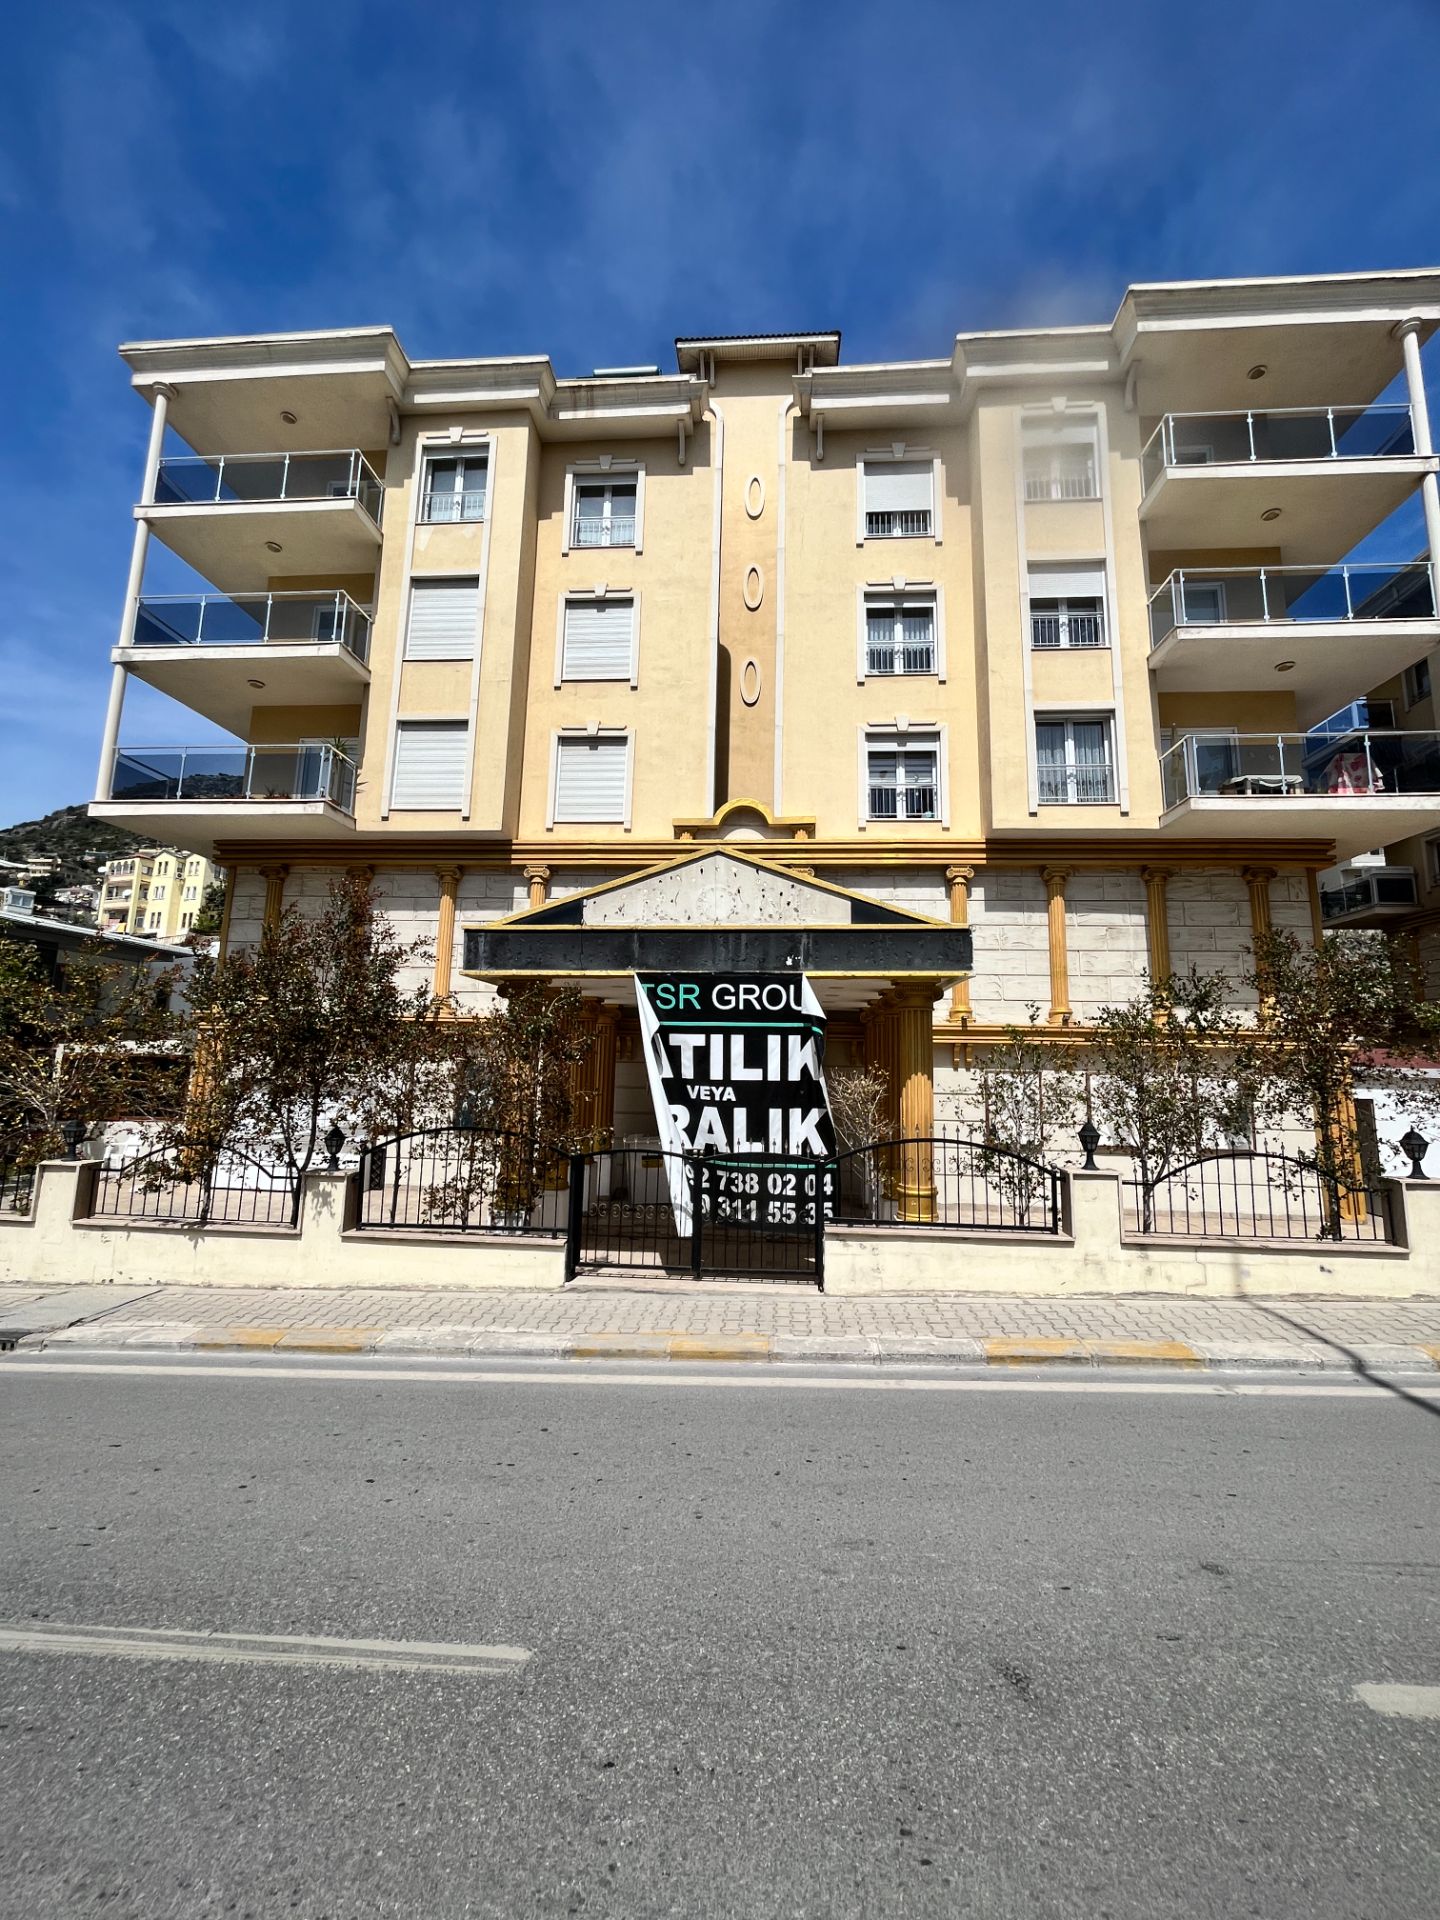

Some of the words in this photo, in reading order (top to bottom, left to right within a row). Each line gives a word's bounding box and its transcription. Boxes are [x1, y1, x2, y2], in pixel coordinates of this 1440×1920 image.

[687, 1085, 736, 1101] VEYA
[716, 1169, 760, 1194] 738
[767, 1173, 797, 1196] 02
[767, 1200, 797, 1225] 55
